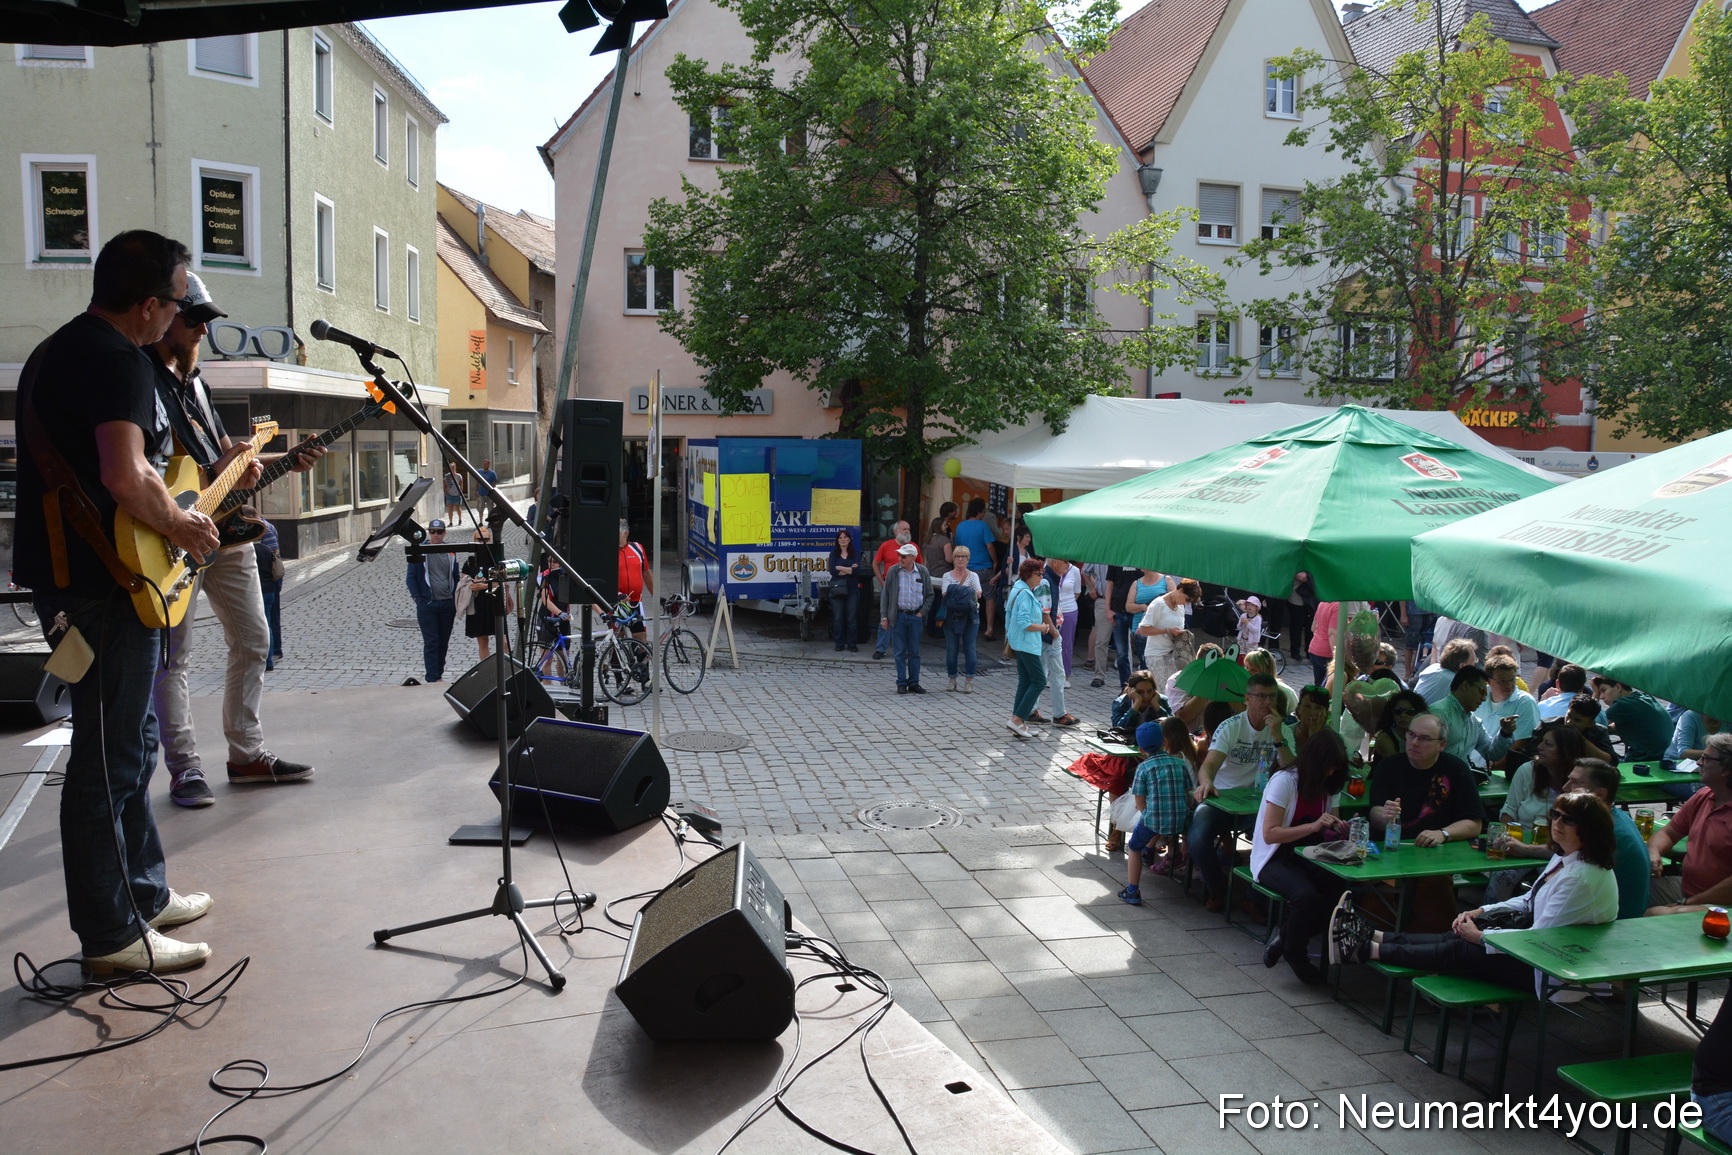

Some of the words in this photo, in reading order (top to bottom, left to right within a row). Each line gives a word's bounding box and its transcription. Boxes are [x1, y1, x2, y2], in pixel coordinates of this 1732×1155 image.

[50, 186, 79, 195] Optiker
[209, 189, 236, 200] Optiker
[45, 207, 86, 217] Schweiger
[204, 204, 241, 216] Schweiger
[208, 220, 237, 231] Contact
[212, 236, 233, 246] linsen
[470, 335, 485, 385] Nudeltreff
[638, 394, 697, 411] DNER
[701, 397, 712, 411] &
[1133, 487, 1262, 504] Lammsbräu
[1400, 487, 1521, 502] Neumarkter
[1560, 504, 1698, 531] Neumarkter
[1497, 519, 1672, 563] Lammsbräu
